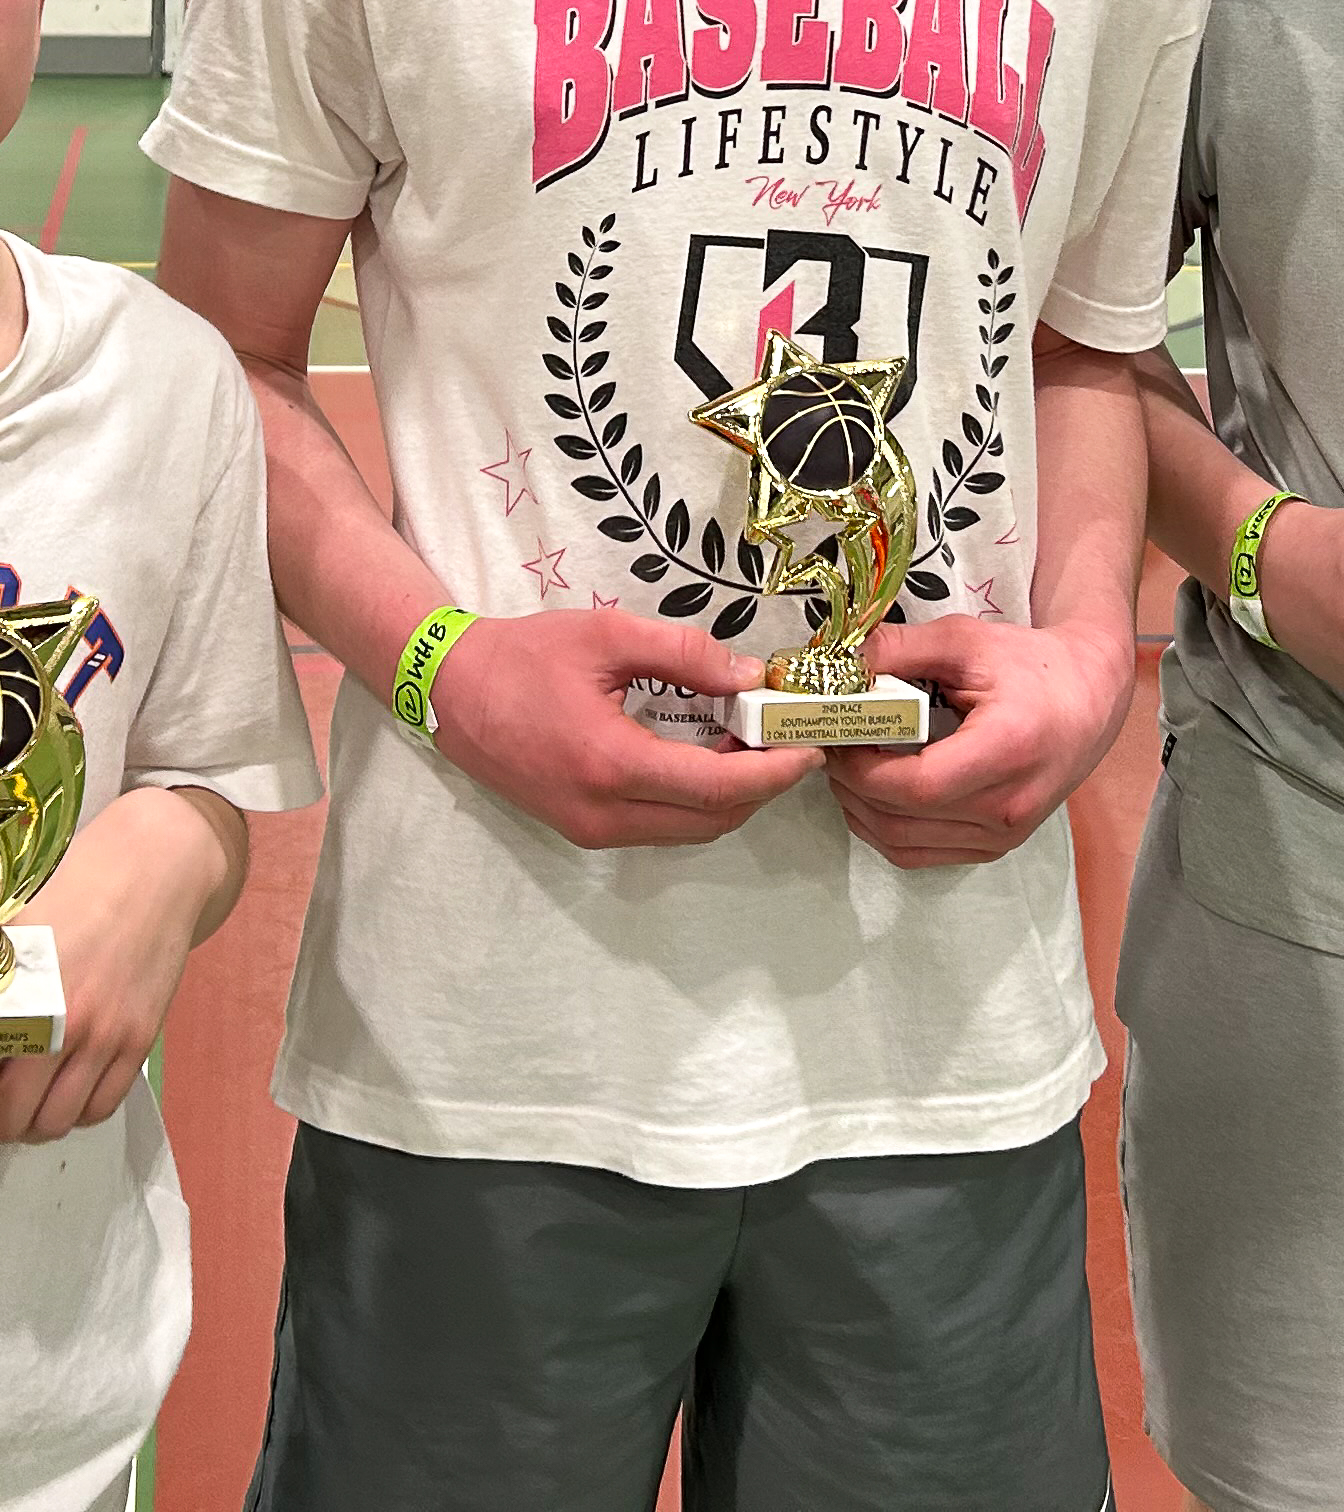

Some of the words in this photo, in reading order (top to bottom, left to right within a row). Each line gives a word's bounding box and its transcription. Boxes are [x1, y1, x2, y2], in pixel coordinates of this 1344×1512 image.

[632, 104, 998, 227] LIFESTYLE
[746, 175, 804, 211] New
[815, 179, 883, 227] York
[822, 704, 839, 713] 2ND
[840, 703, 862, 713] PLACE
[659, 711, 716, 723] BASEBALL
[781, 717, 839, 727] SOUTHAMPTON
[840, 716, 867, 726] YOUTH
[766, 731, 772, 740] 3
[773, 731, 787, 740] ON
[788, 730, 794, 739] 3
[795, 729, 838, 739] BASKETBALL
[839, 727, 891, 738] TOURNAMENT
[897, 726, 916, 737] 2026
